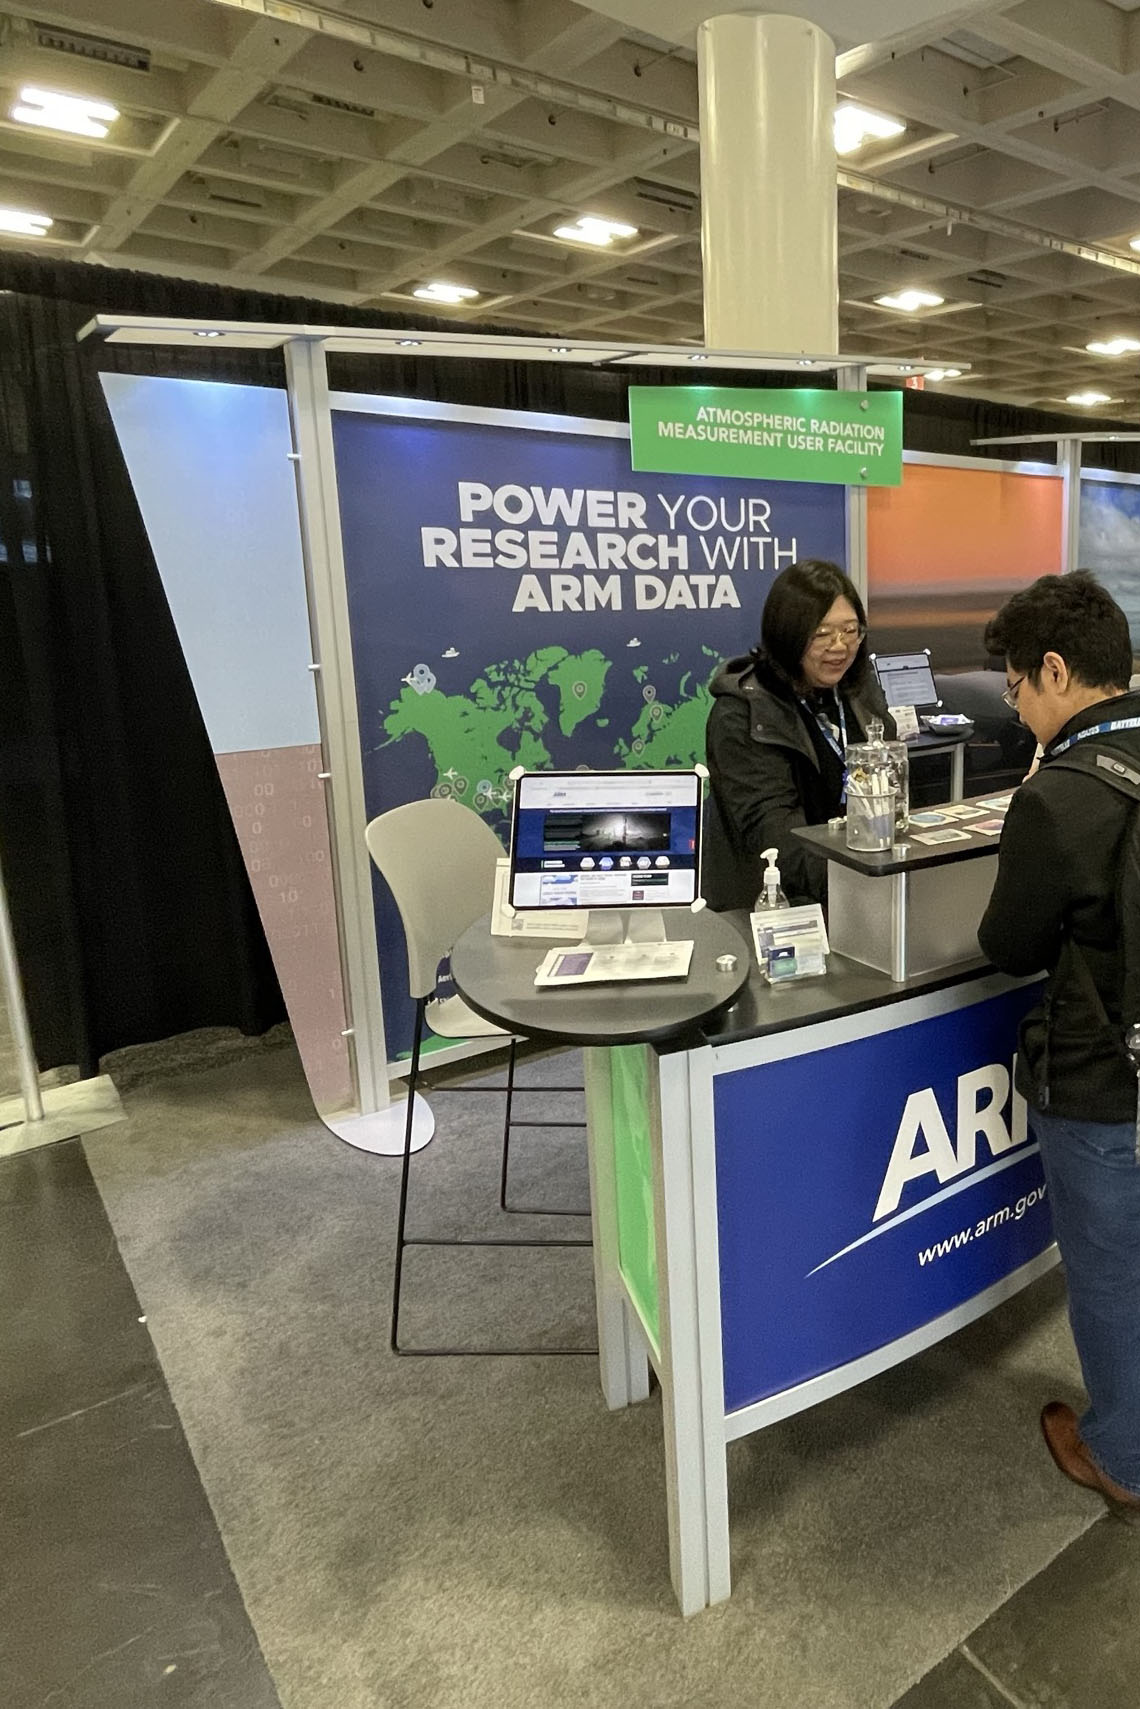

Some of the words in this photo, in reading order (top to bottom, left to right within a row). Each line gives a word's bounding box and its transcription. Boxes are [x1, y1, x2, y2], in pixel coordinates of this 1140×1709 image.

[658, 421, 783, 448] MEASUREMENT
[787, 435, 824, 451] USER
[827, 439, 885, 457] FACILITY
[696, 406, 806, 433] ATMOSPHERIC
[810, 419, 885, 440] RADIATION
[458, 481, 647, 529] POWER
[657, 493, 771, 532] YOUR
[421, 527, 688, 570] RESEARCH
[699, 535, 797, 570] WITH
[512, 574, 623, 612] ARM
[634, 574, 741, 610] DATA
[917, 1184, 1048, 1267] www.arm.gov
